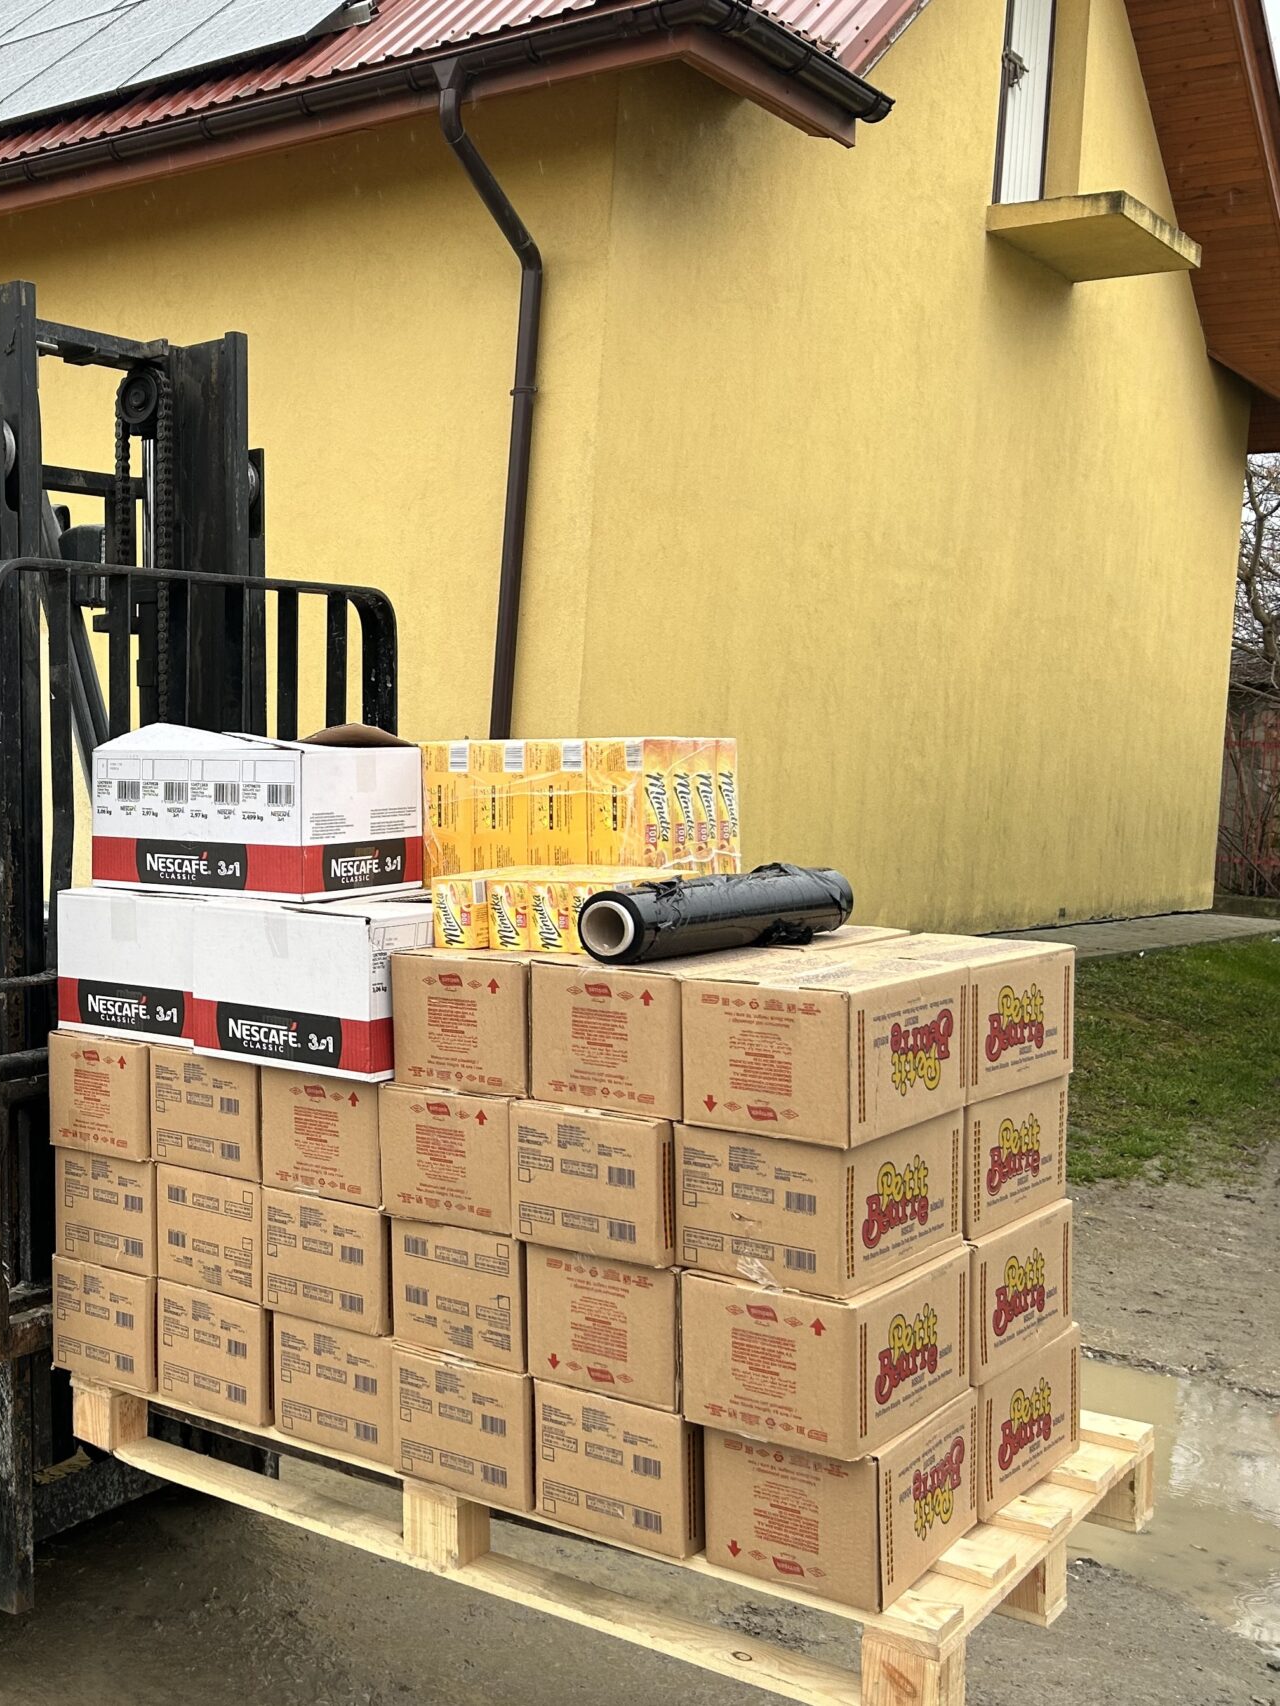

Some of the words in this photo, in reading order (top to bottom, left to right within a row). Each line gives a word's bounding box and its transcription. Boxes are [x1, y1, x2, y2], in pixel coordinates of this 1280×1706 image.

[645, 772, 670, 842] Minutka
[673, 773, 695, 841] Minutka
[696, 772, 716, 839] Minutka
[718, 771, 738, 837] Minutka
[146, 851, 209, 875] NESCAFÉ
[159, 872, 197, 881] CLASSIC
[331, 849, 379, 878] NESCAFÉ
[341, 875, 370, 884] CLASSIC
[436, 892, 465, 946] Minutka
[490, 893, 520, 948] Minutka
[532, 894, 563, 949] Minutka
[87, 993, 147, 1019] NESCAFÉ
[100, 1014, 136, 1024] CLASSIC
[228, 1018, 299, 1048] NESCAFÉ
[998, 982, 1044, 1031] Petit
[243, 1040, 284, 1053] CLASSIC
[891, 1042, 941, 1097] Petit
[998, 1112, 1040, 1162] Petit
[877, 1154, 929, 1212] Petit
[1004, 1247, 1045, 1302] Petit
[888, 1302, 938, 1366] Petit
[1010, 1376, 1051, 1435] Petit
[914, 1473, 954, 1541] Petit
